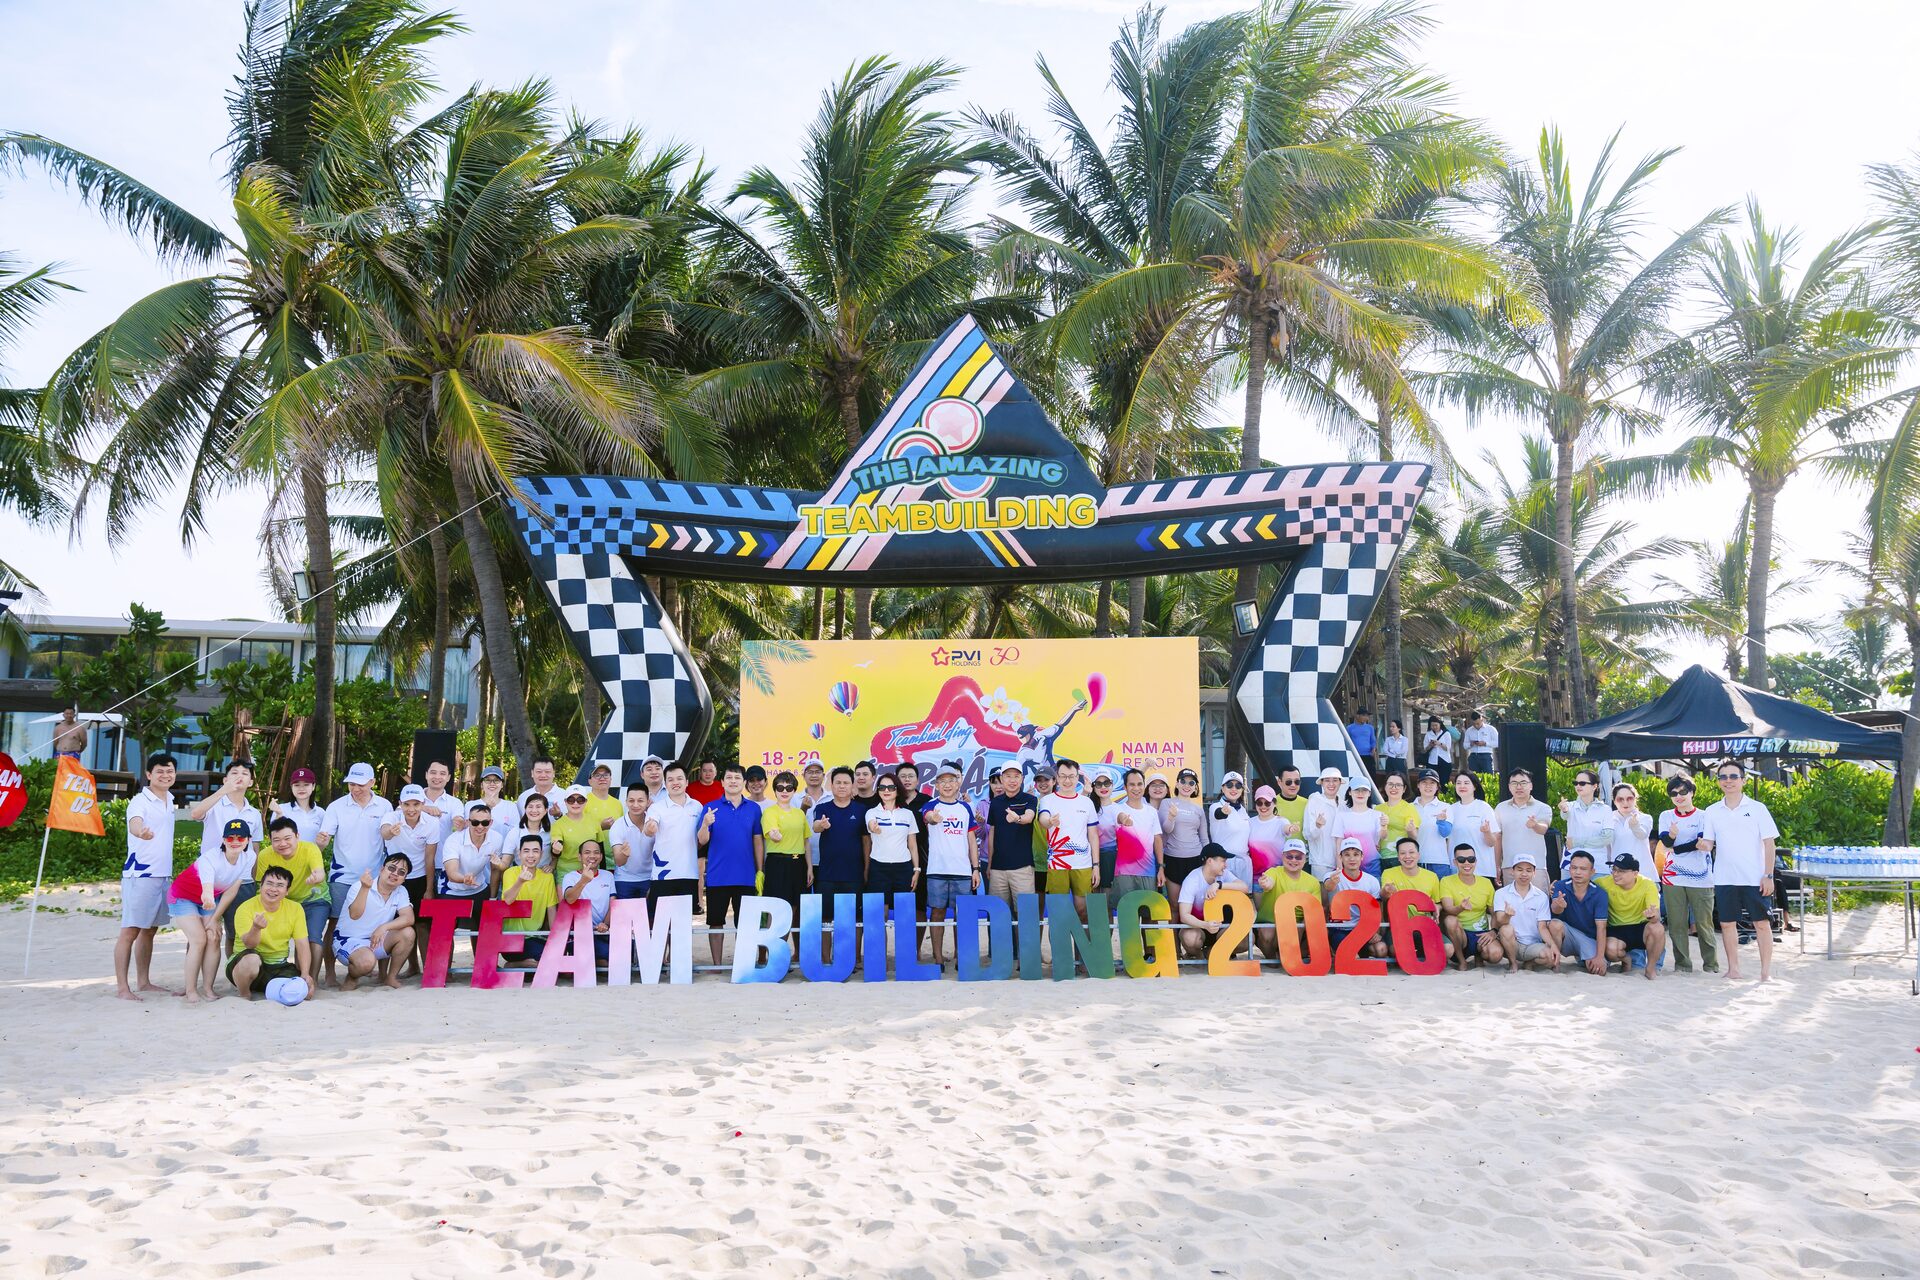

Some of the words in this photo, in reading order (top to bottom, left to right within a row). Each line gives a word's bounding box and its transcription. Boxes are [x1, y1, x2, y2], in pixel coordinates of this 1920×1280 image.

[855, 459, 909, 491] THE
[917, 455, 1063, 482] AMAZING
[799, 496, 1096, 536] TEAMBUILDING
[951, 650, 981, 661] PVI
[886, 720, 976, 749] Teambuilding
[1122, 742, 1158, 754] NAM
[1162, 742, 1184, 754] AN
[1682, 740, 1719, 755] KHU
[762, 751, 784, 766] 18
[1123, 757, 1185, 768] REORT
[70, 796, 95, 814] 02
[942, 820, 963, 829] PVI
[419, 894, 693, 989] TEAM
[731, 889, 1180, 983] BUILDING
[1203, 889, 1447, 977] 2026
